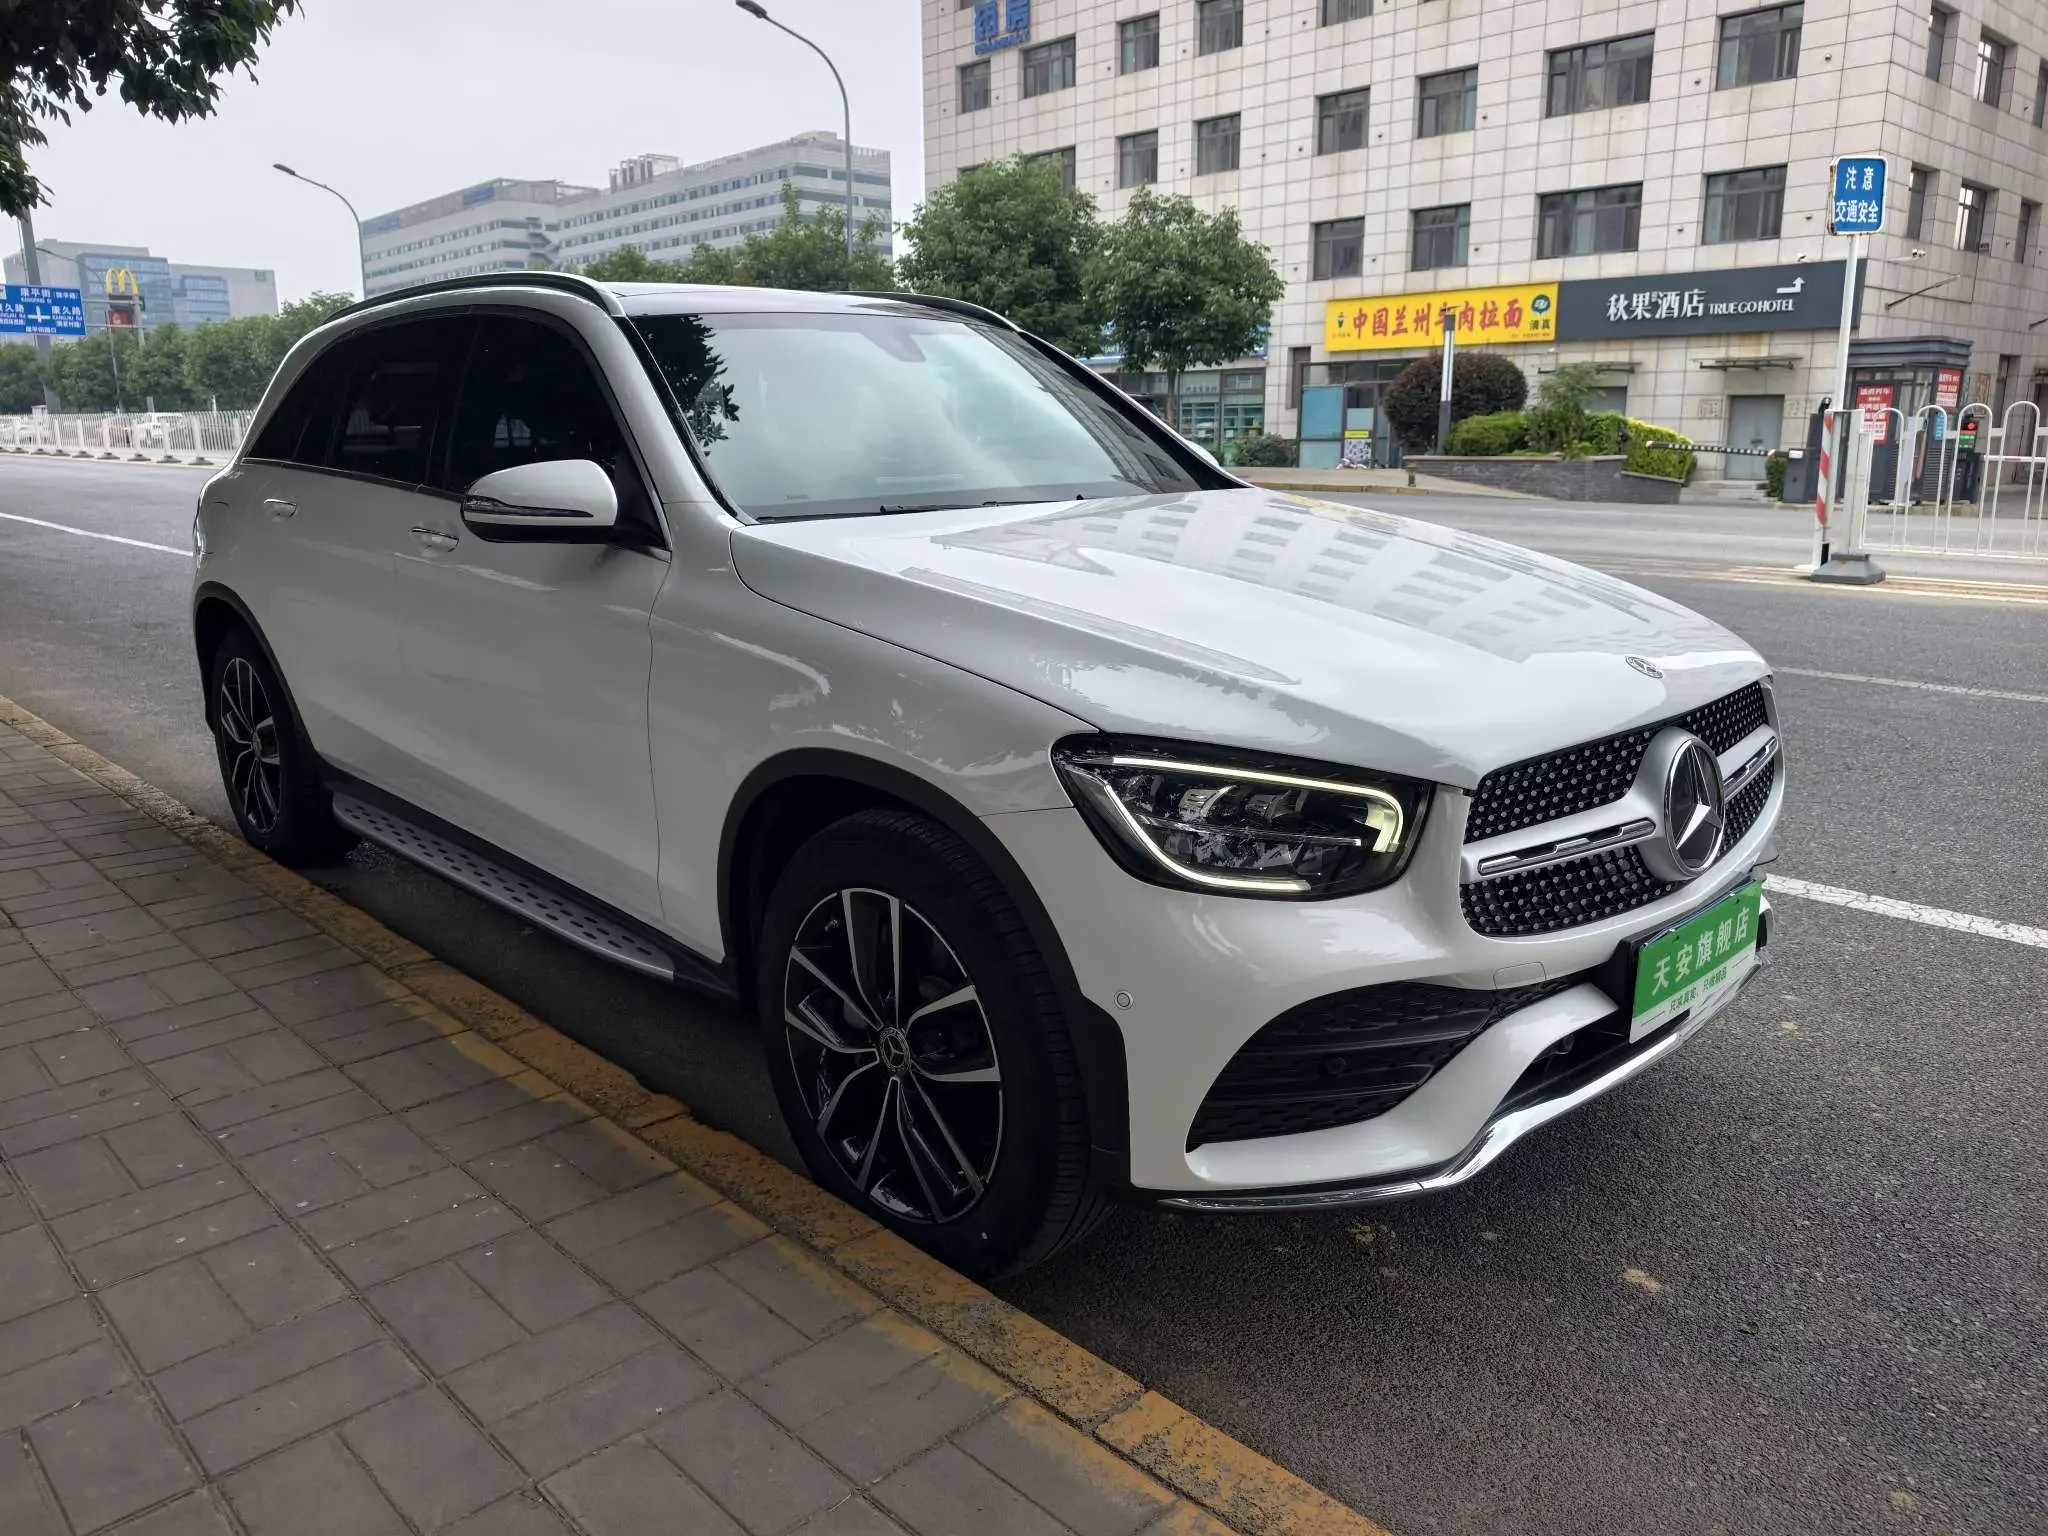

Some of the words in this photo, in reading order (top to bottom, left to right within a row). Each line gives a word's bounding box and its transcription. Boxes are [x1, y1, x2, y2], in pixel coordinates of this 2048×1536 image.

[1845, 165, 1874, 191] 注意
[1835, 199, 1879, 223] 交通安全
[1606, 288, 1707, 322] 秋果酒店
[1652, 907, 1750, 996] 天安旗舰店
